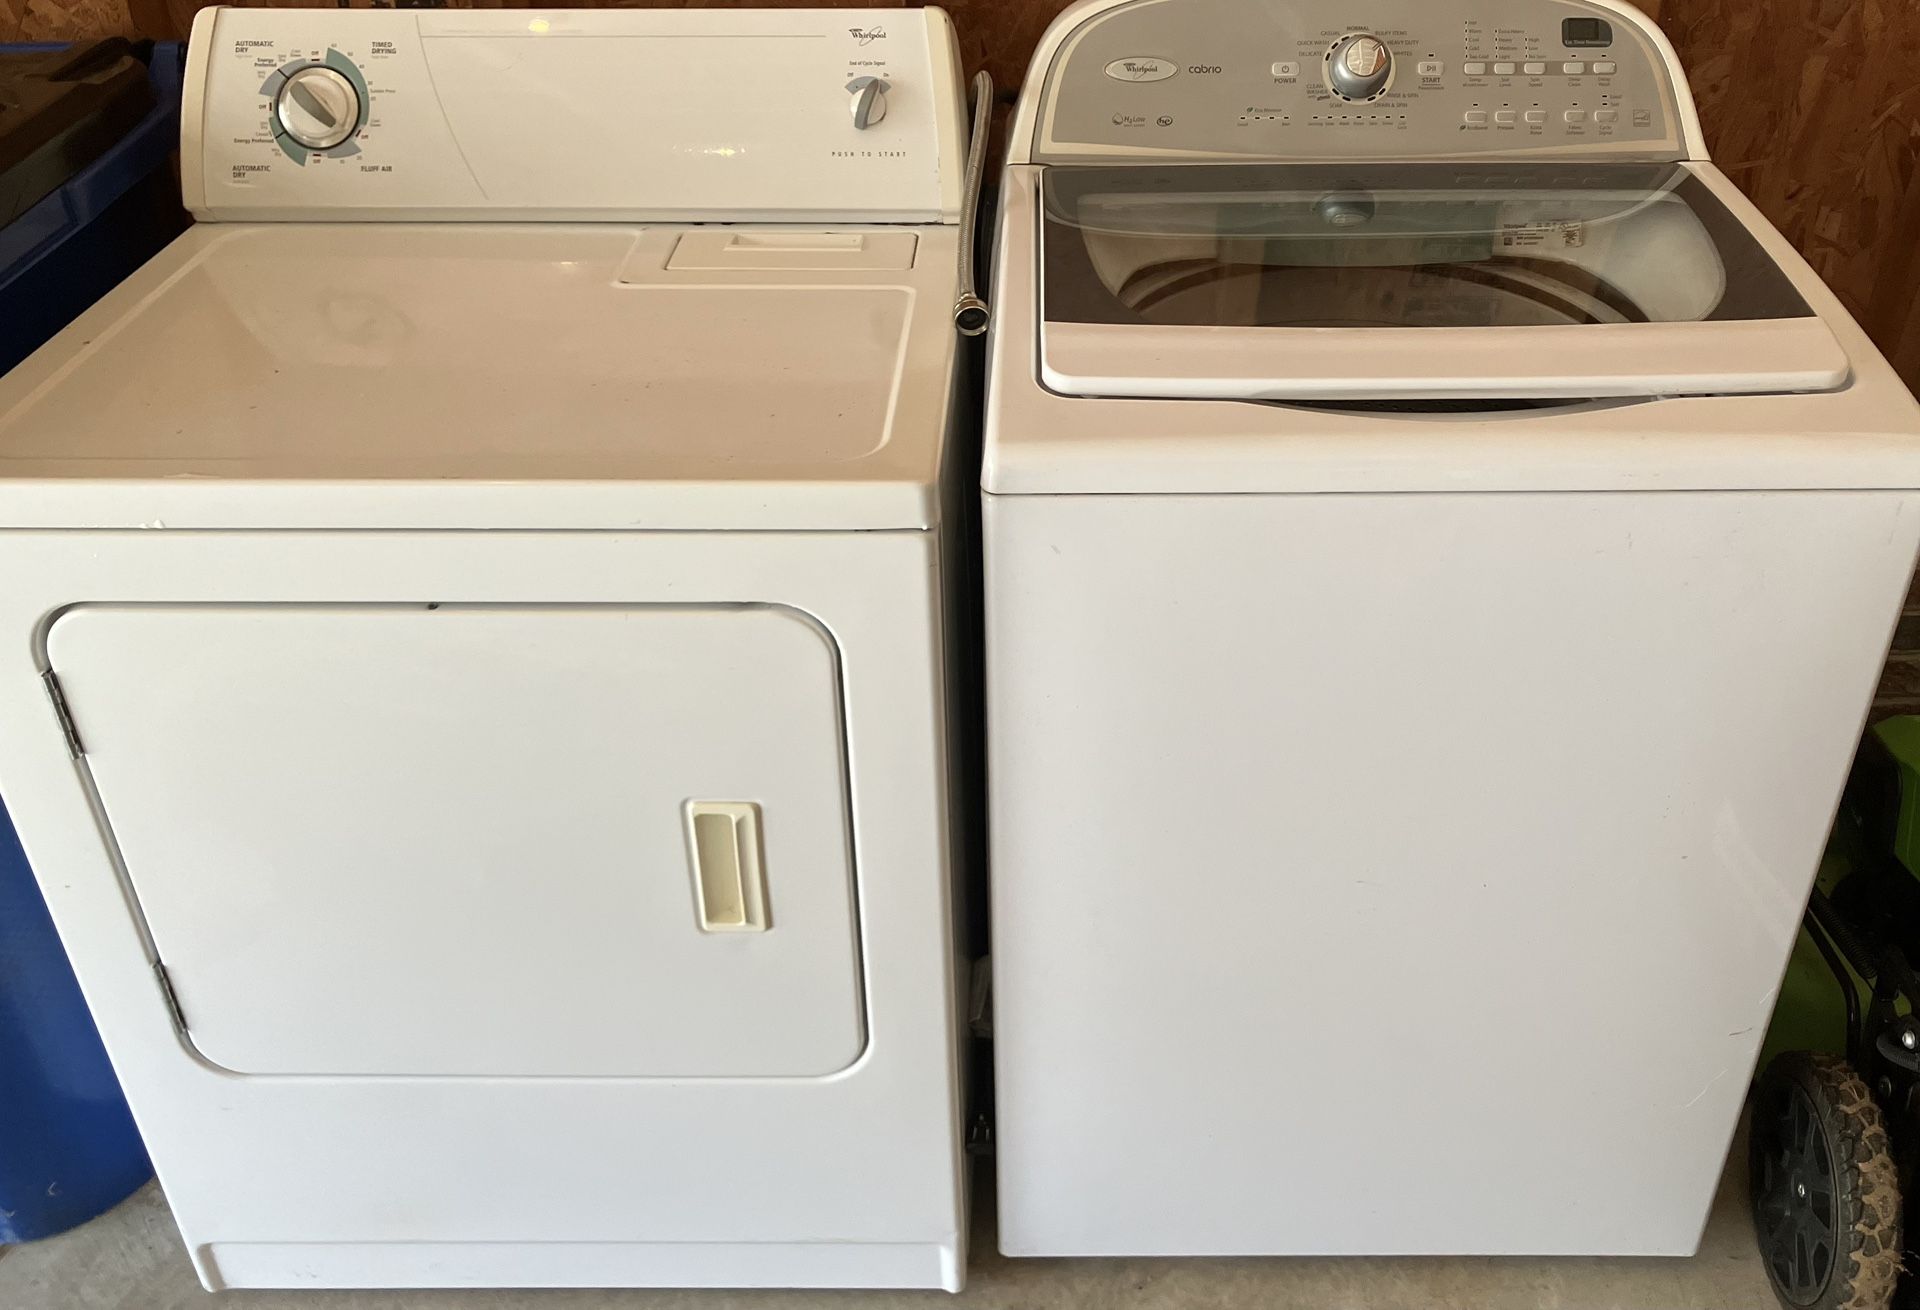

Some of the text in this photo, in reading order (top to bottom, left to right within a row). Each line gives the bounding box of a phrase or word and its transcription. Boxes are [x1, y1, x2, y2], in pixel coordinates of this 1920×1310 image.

[848, 28, 887, 41] Whirlpool
[1123, 63, 1158, 74] Whirlpool
[1188, 64, 1222, 74] cabrio
